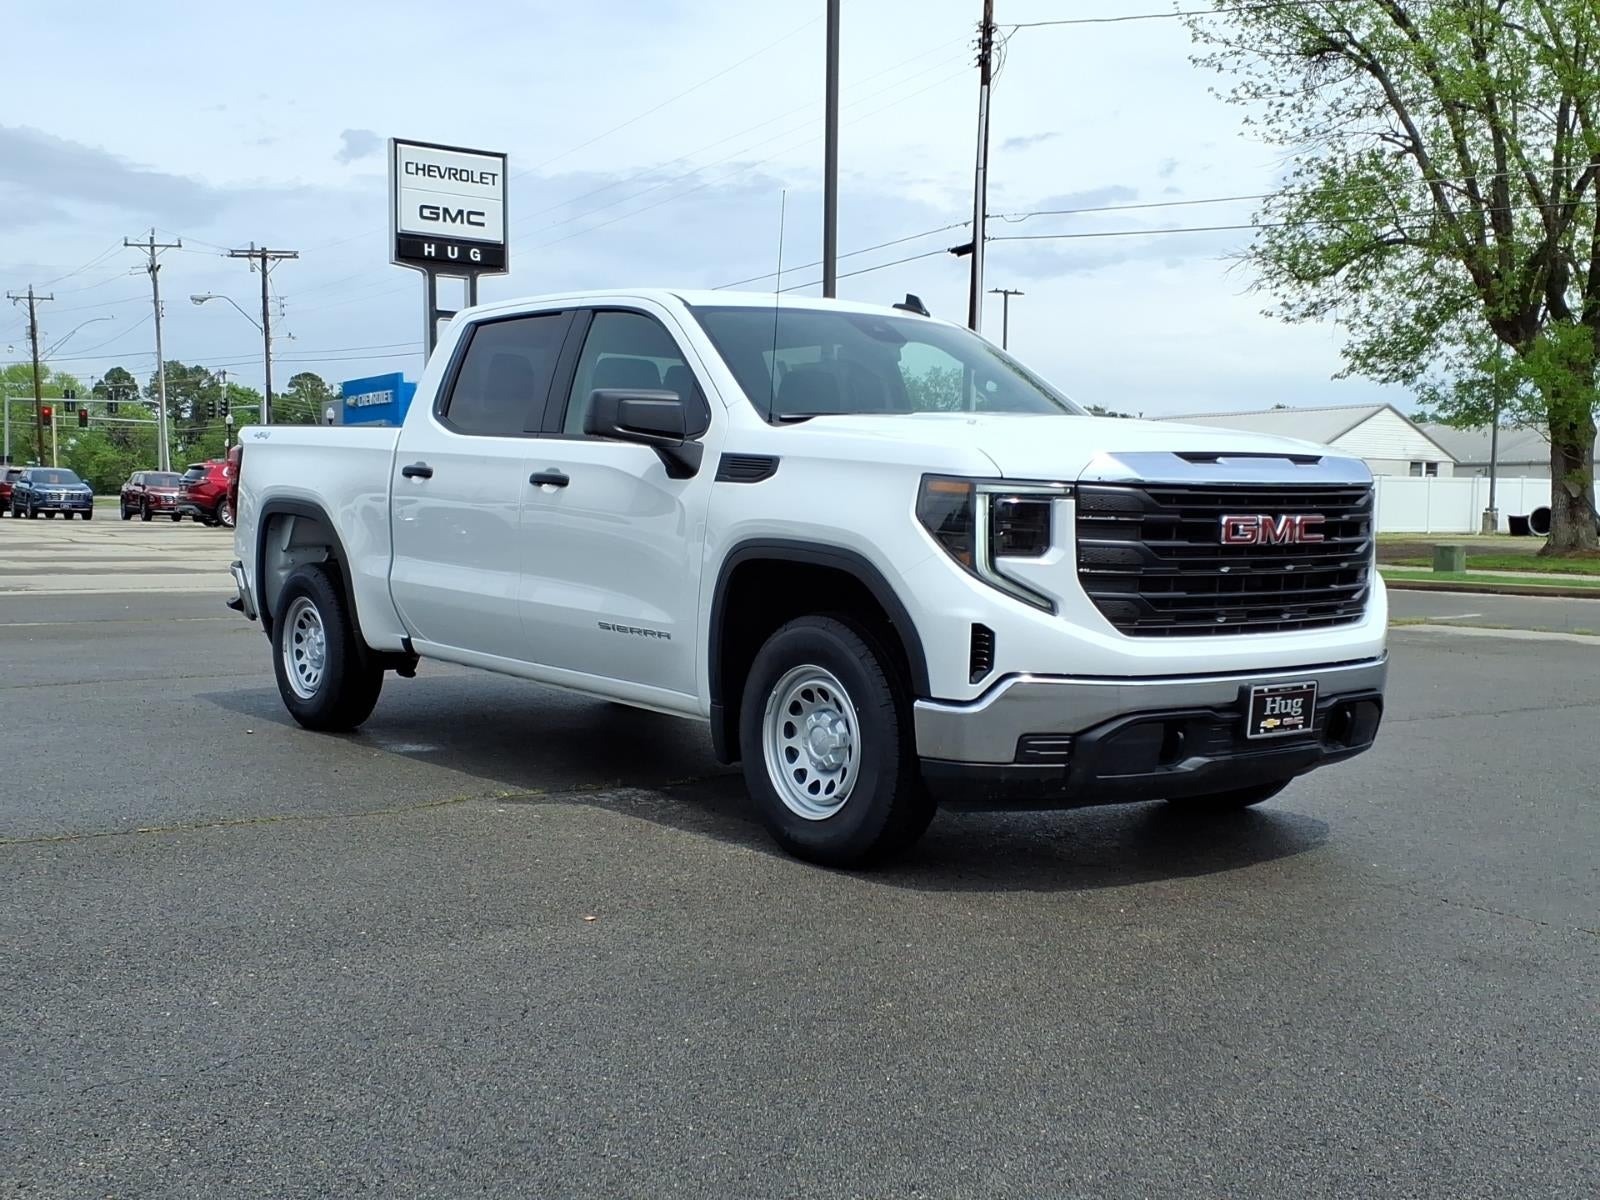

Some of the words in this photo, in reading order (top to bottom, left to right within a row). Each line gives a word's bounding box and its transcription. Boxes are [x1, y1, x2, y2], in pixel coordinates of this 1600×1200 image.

[405, 161, 498, 186] CHEVROLET
[419, 204, 485, 227] GMC
[424, 243, 481, 261] HUG
[358, 390, 393, 407] CHEVROLET
[1221, 513, 1325, 544] GMC
[598, 621, 671, 640] SIERRA
[1263, 696, 1304, 716] Hug
